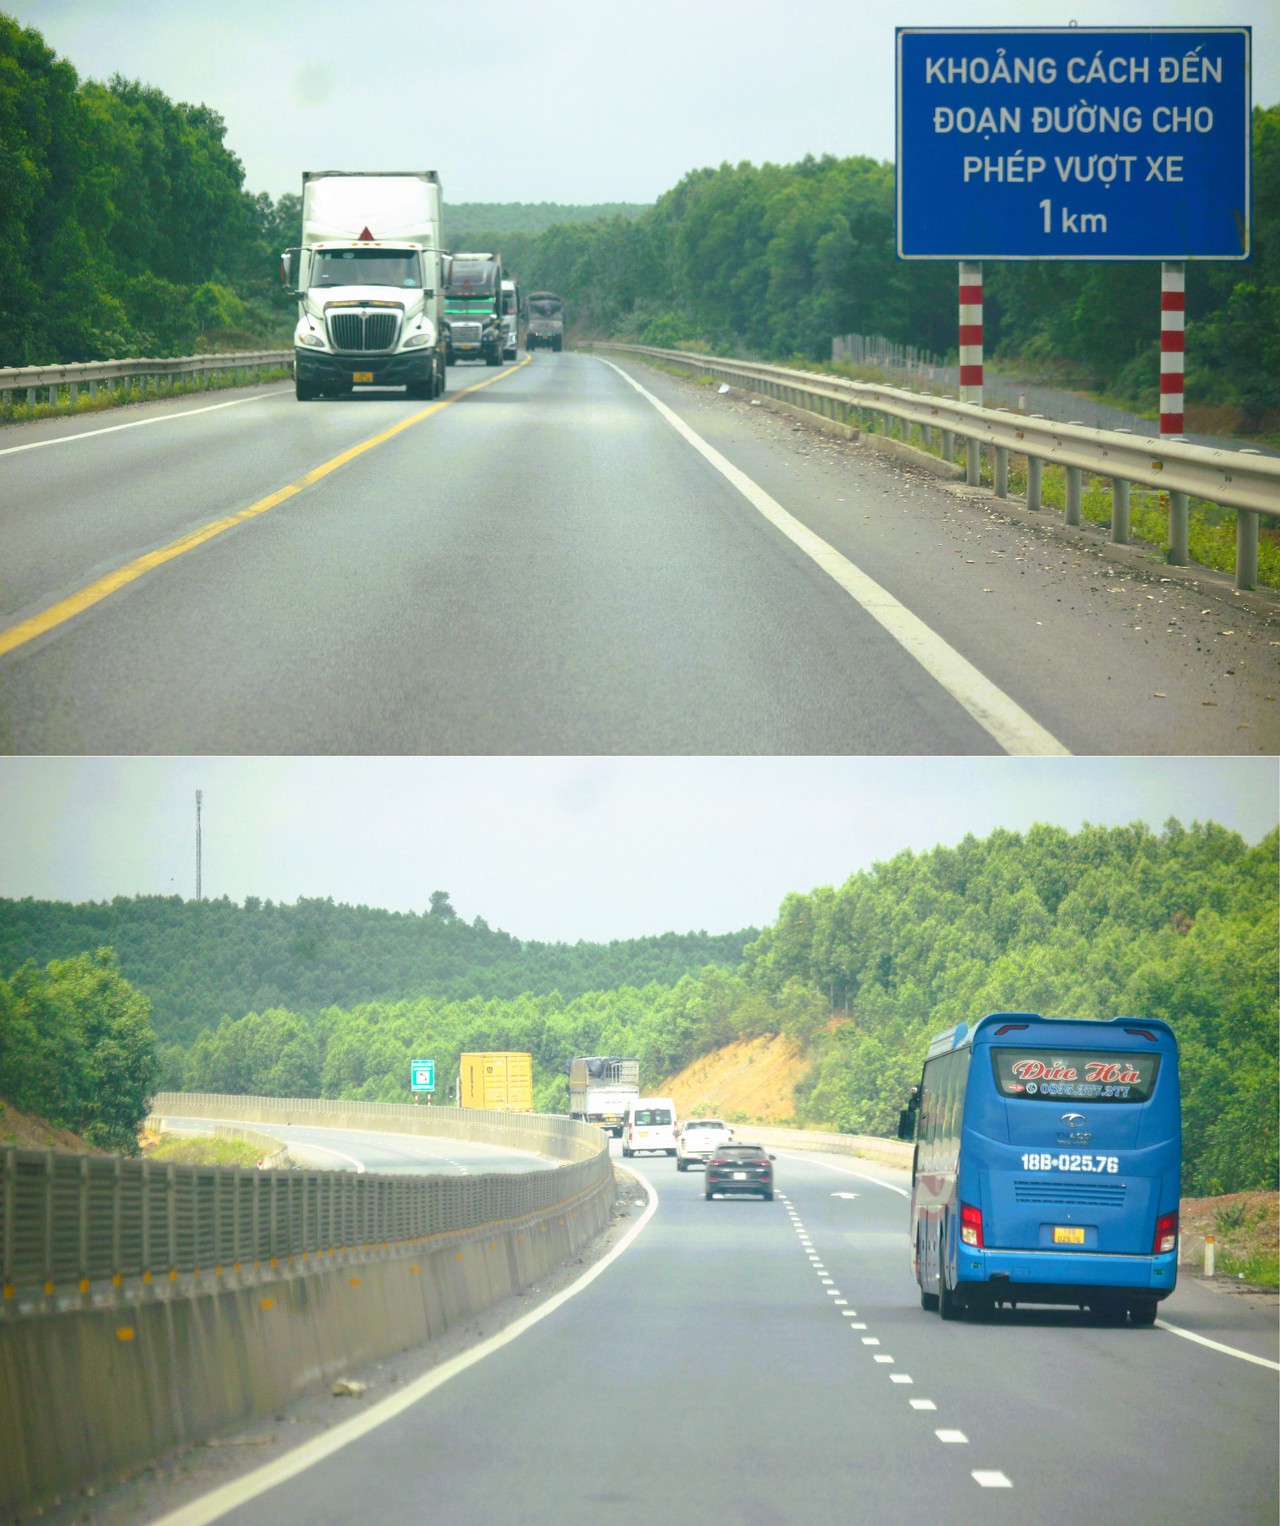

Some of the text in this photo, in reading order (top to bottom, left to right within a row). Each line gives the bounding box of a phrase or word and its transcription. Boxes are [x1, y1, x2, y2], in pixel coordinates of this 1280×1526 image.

[926, 44, 1222, 84] KHOẢNG CÁCH ĐẾN
[932, 99, 1214, 140] ĐOẠN ĐƯỜNG CHO
[963, 149, 1185, 189] PHÉP VƯỢT XE
[1039, 199, 1108, 233] 1 km
[1011, 1059, 1142, 1084] Đức Hà
